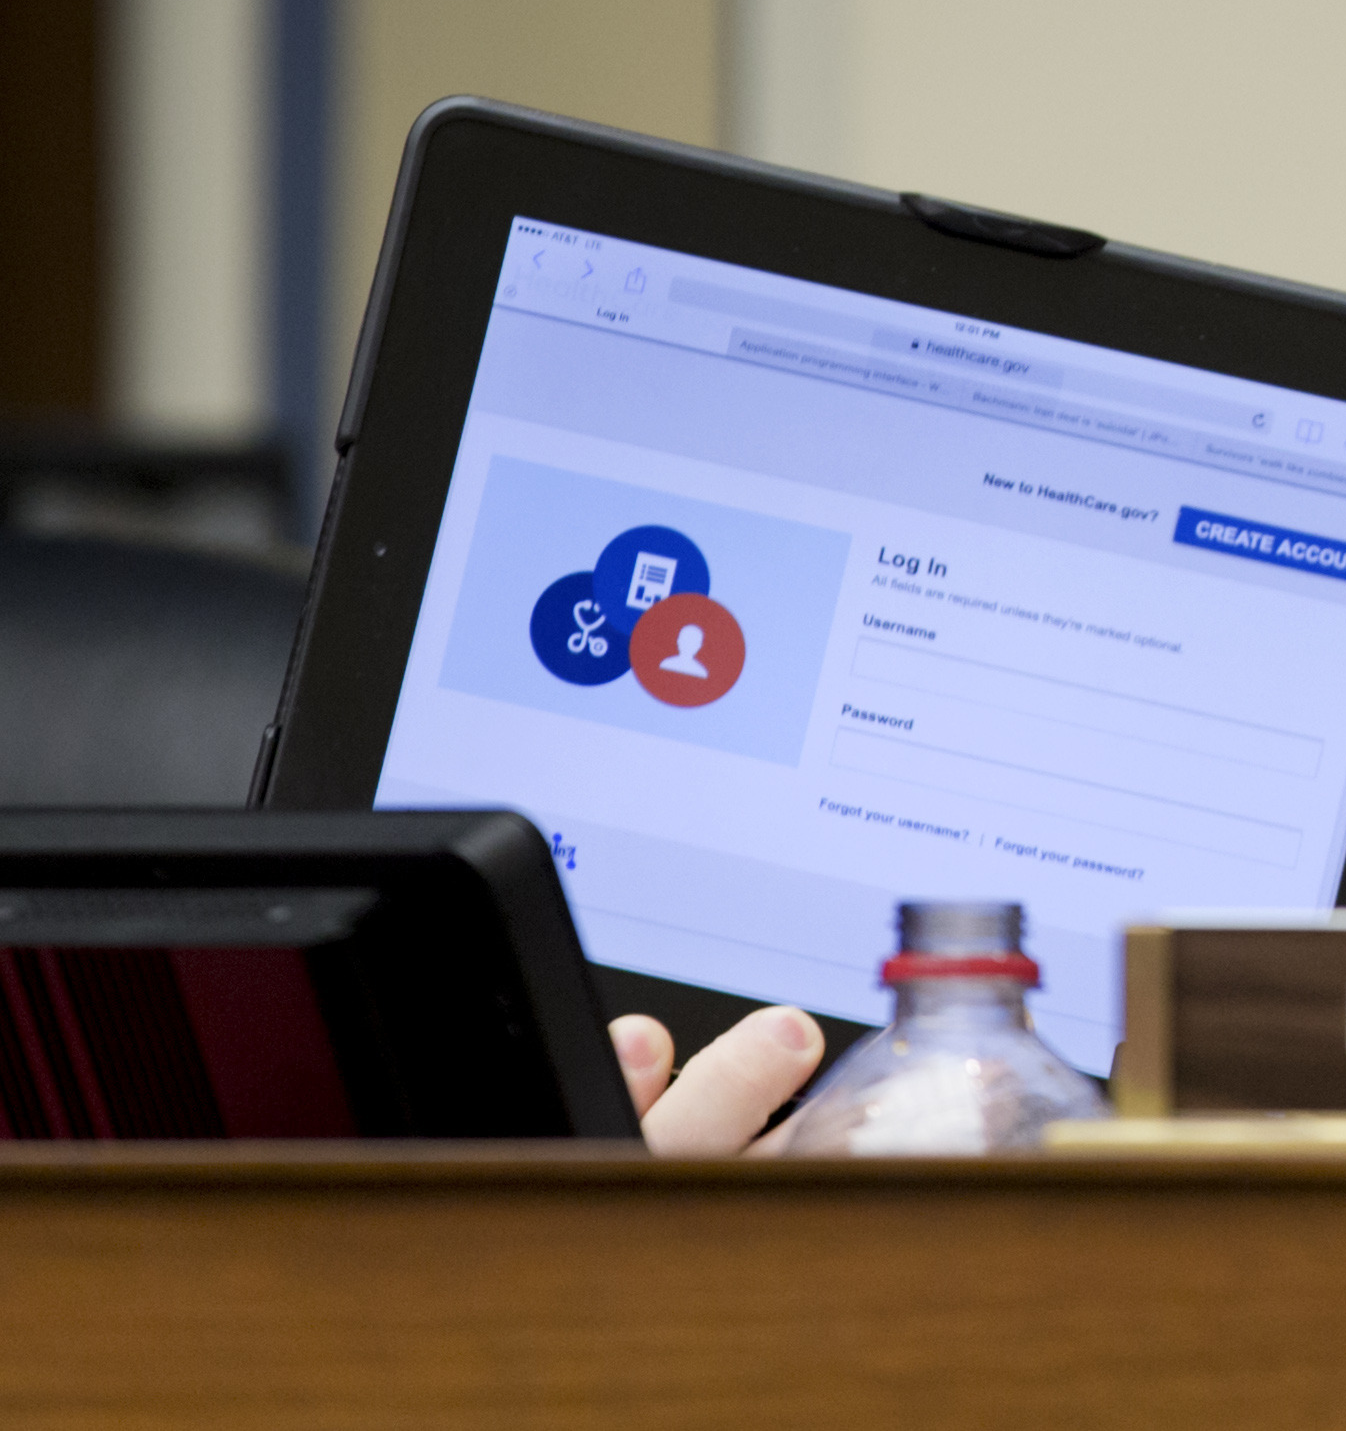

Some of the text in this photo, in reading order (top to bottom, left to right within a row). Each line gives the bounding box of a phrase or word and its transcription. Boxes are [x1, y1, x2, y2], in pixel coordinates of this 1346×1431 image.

[552, 232, 578, 245] AT&T
[597, 307, 616, 322] Log
[982, 328, 1001, 339] PM
[740, 339, 799, 362] Application
[800, 354, 870, 381] programming
[872, 370, 919, 388] interface
[926, 340, 1030, 373] healthcare.gov
[983, 472, 1159, 523] New to HealthCare.gov?
[1195, 519, 1275, 556] CREATE
[878, 546, 948, 578] Log In
[862, 613, 937, 641] Username
[871, 574, 1184, 654] All fields are required unless they're marked optional.
[841, 703, 914, 731] Password
[819, 797, 863, 821] Forgot
[865, 809, 895, 828] your
[898, 816, 970, 843] username?
[994, 836, 1038, 861] Forgot
[1040, 848, 1071, 867] your
[1073, 855, 1145, 881] password?
